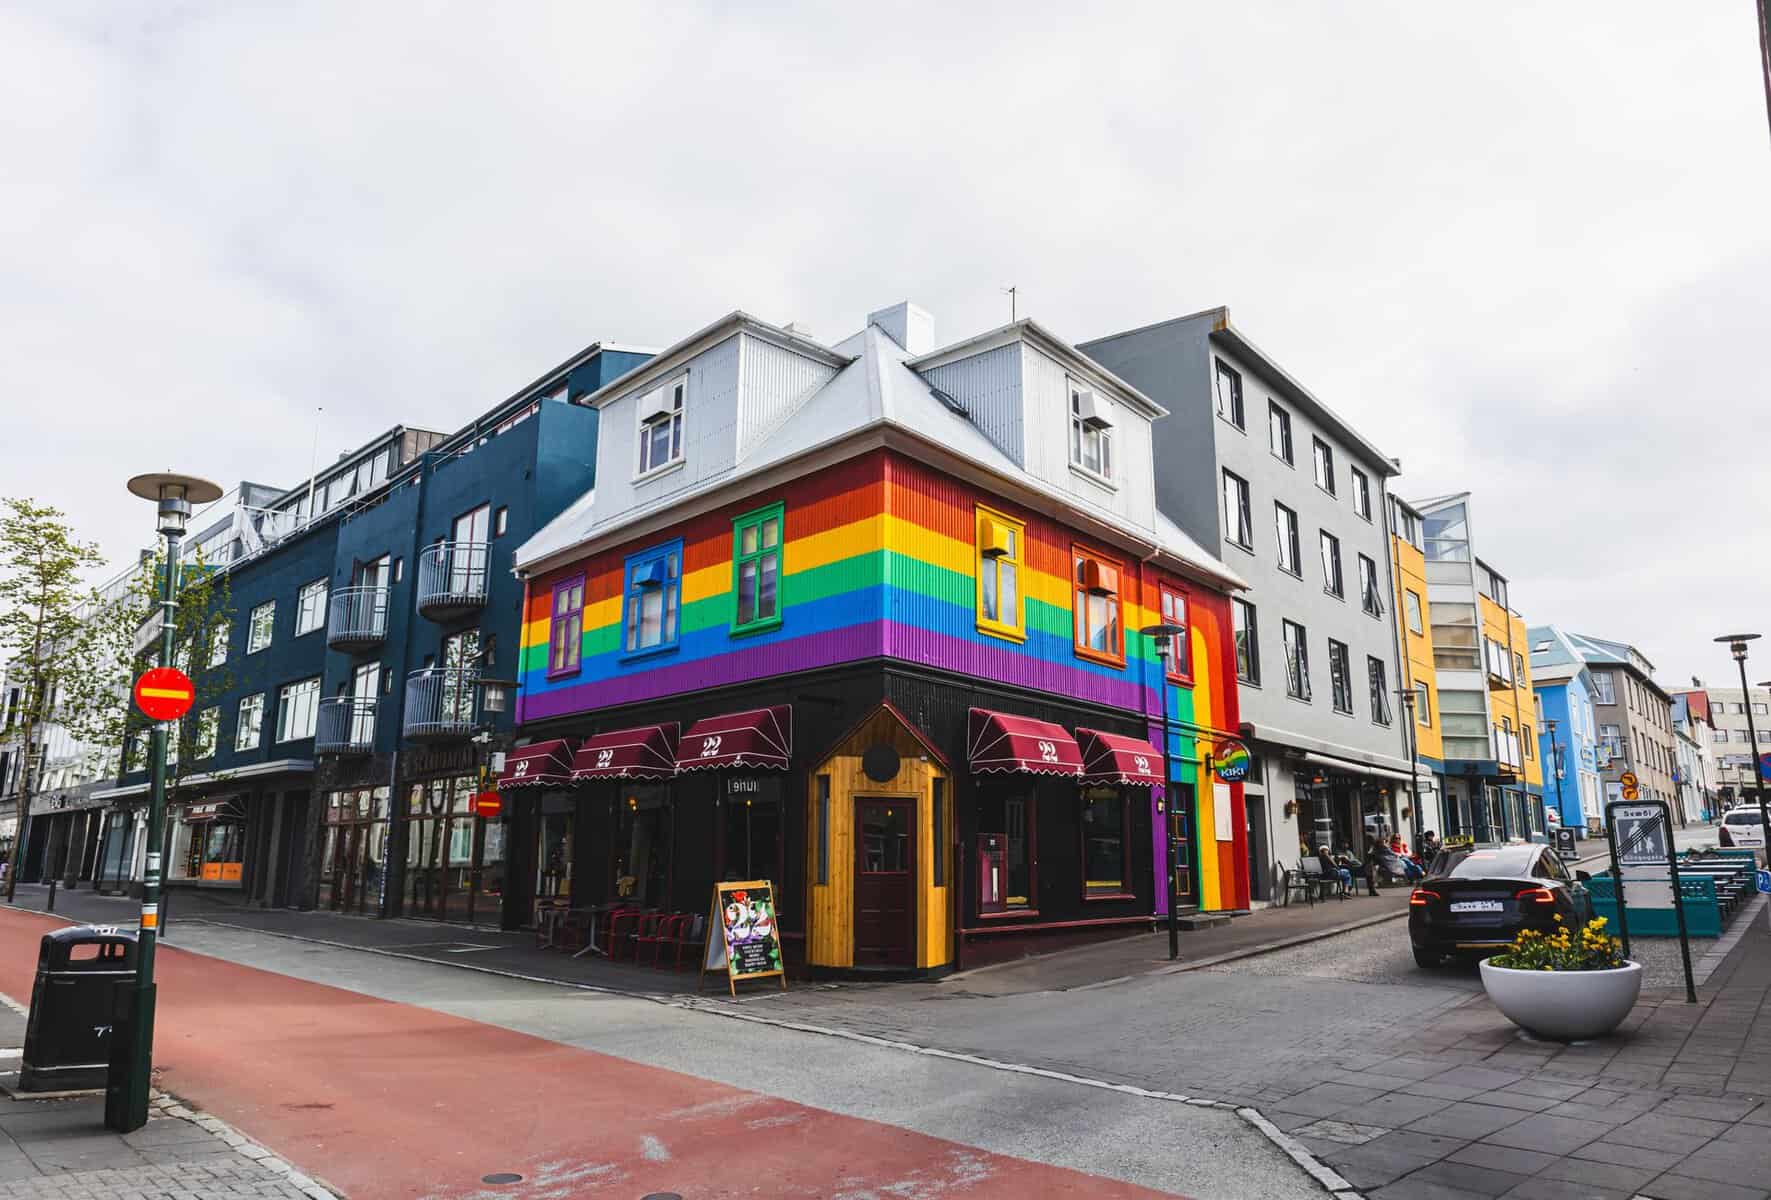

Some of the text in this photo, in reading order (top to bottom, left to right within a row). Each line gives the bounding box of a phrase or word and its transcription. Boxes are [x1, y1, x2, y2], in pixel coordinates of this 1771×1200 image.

[702, 736, 722, 757] 22
[1038, 741, 1059, 762] 22
[513, 760, 529, 777] 22
[595, 749, 614, 768] 22
[1134, 755, 1152, 775] 22
[1220, 767, 1246, 777] KIKI
[726, 902, 772, 939] 22
